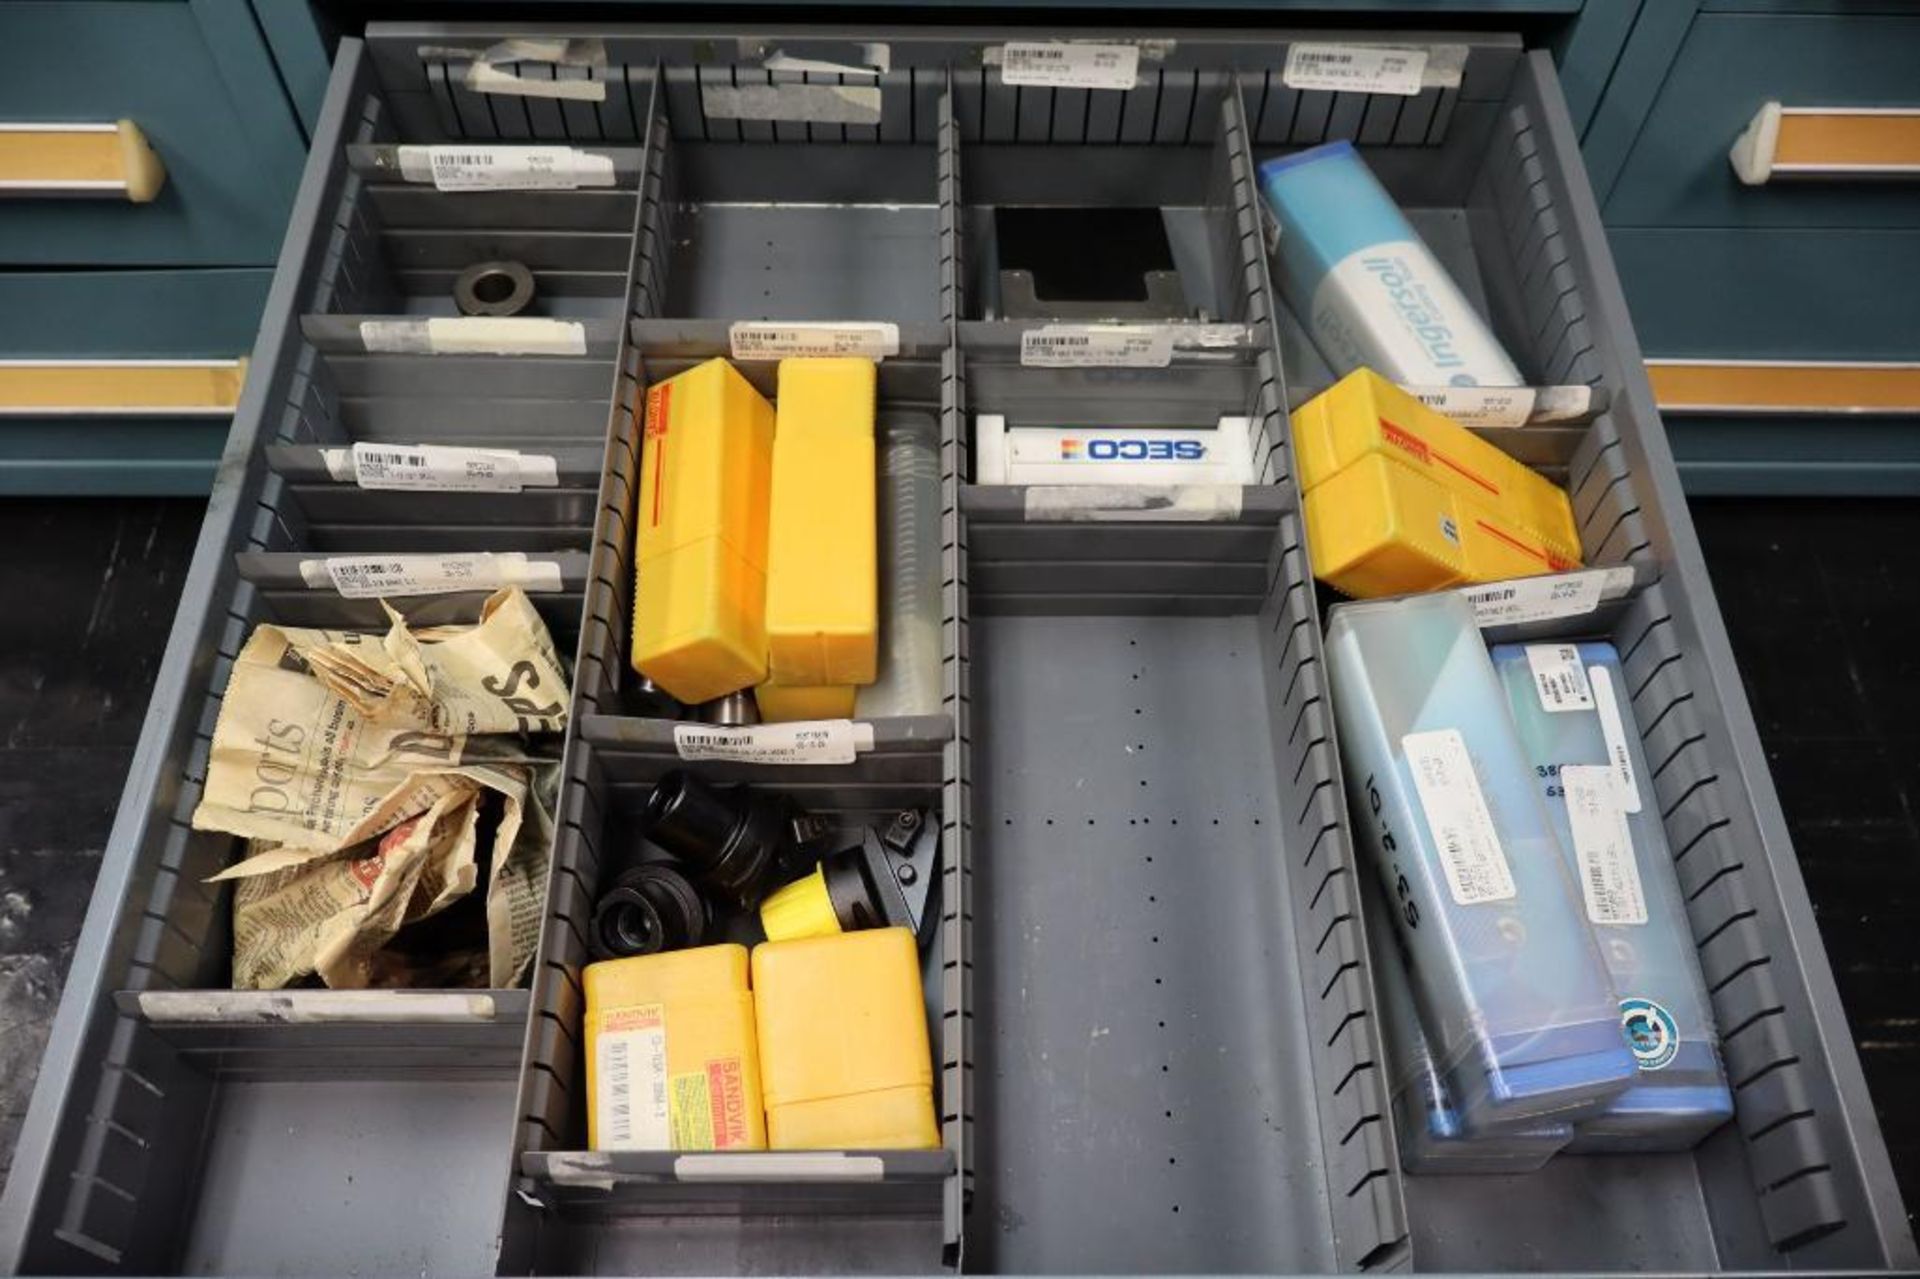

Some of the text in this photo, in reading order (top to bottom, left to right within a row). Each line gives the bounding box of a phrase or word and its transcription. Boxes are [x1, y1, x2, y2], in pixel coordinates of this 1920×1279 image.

[1361, 258, 1465, 368] Ingersoll
[1087, 439, 1208, 460] SECO
[248, 717, 306, 815] parts
[722, 1061, 748, 1144] SANDVIK
